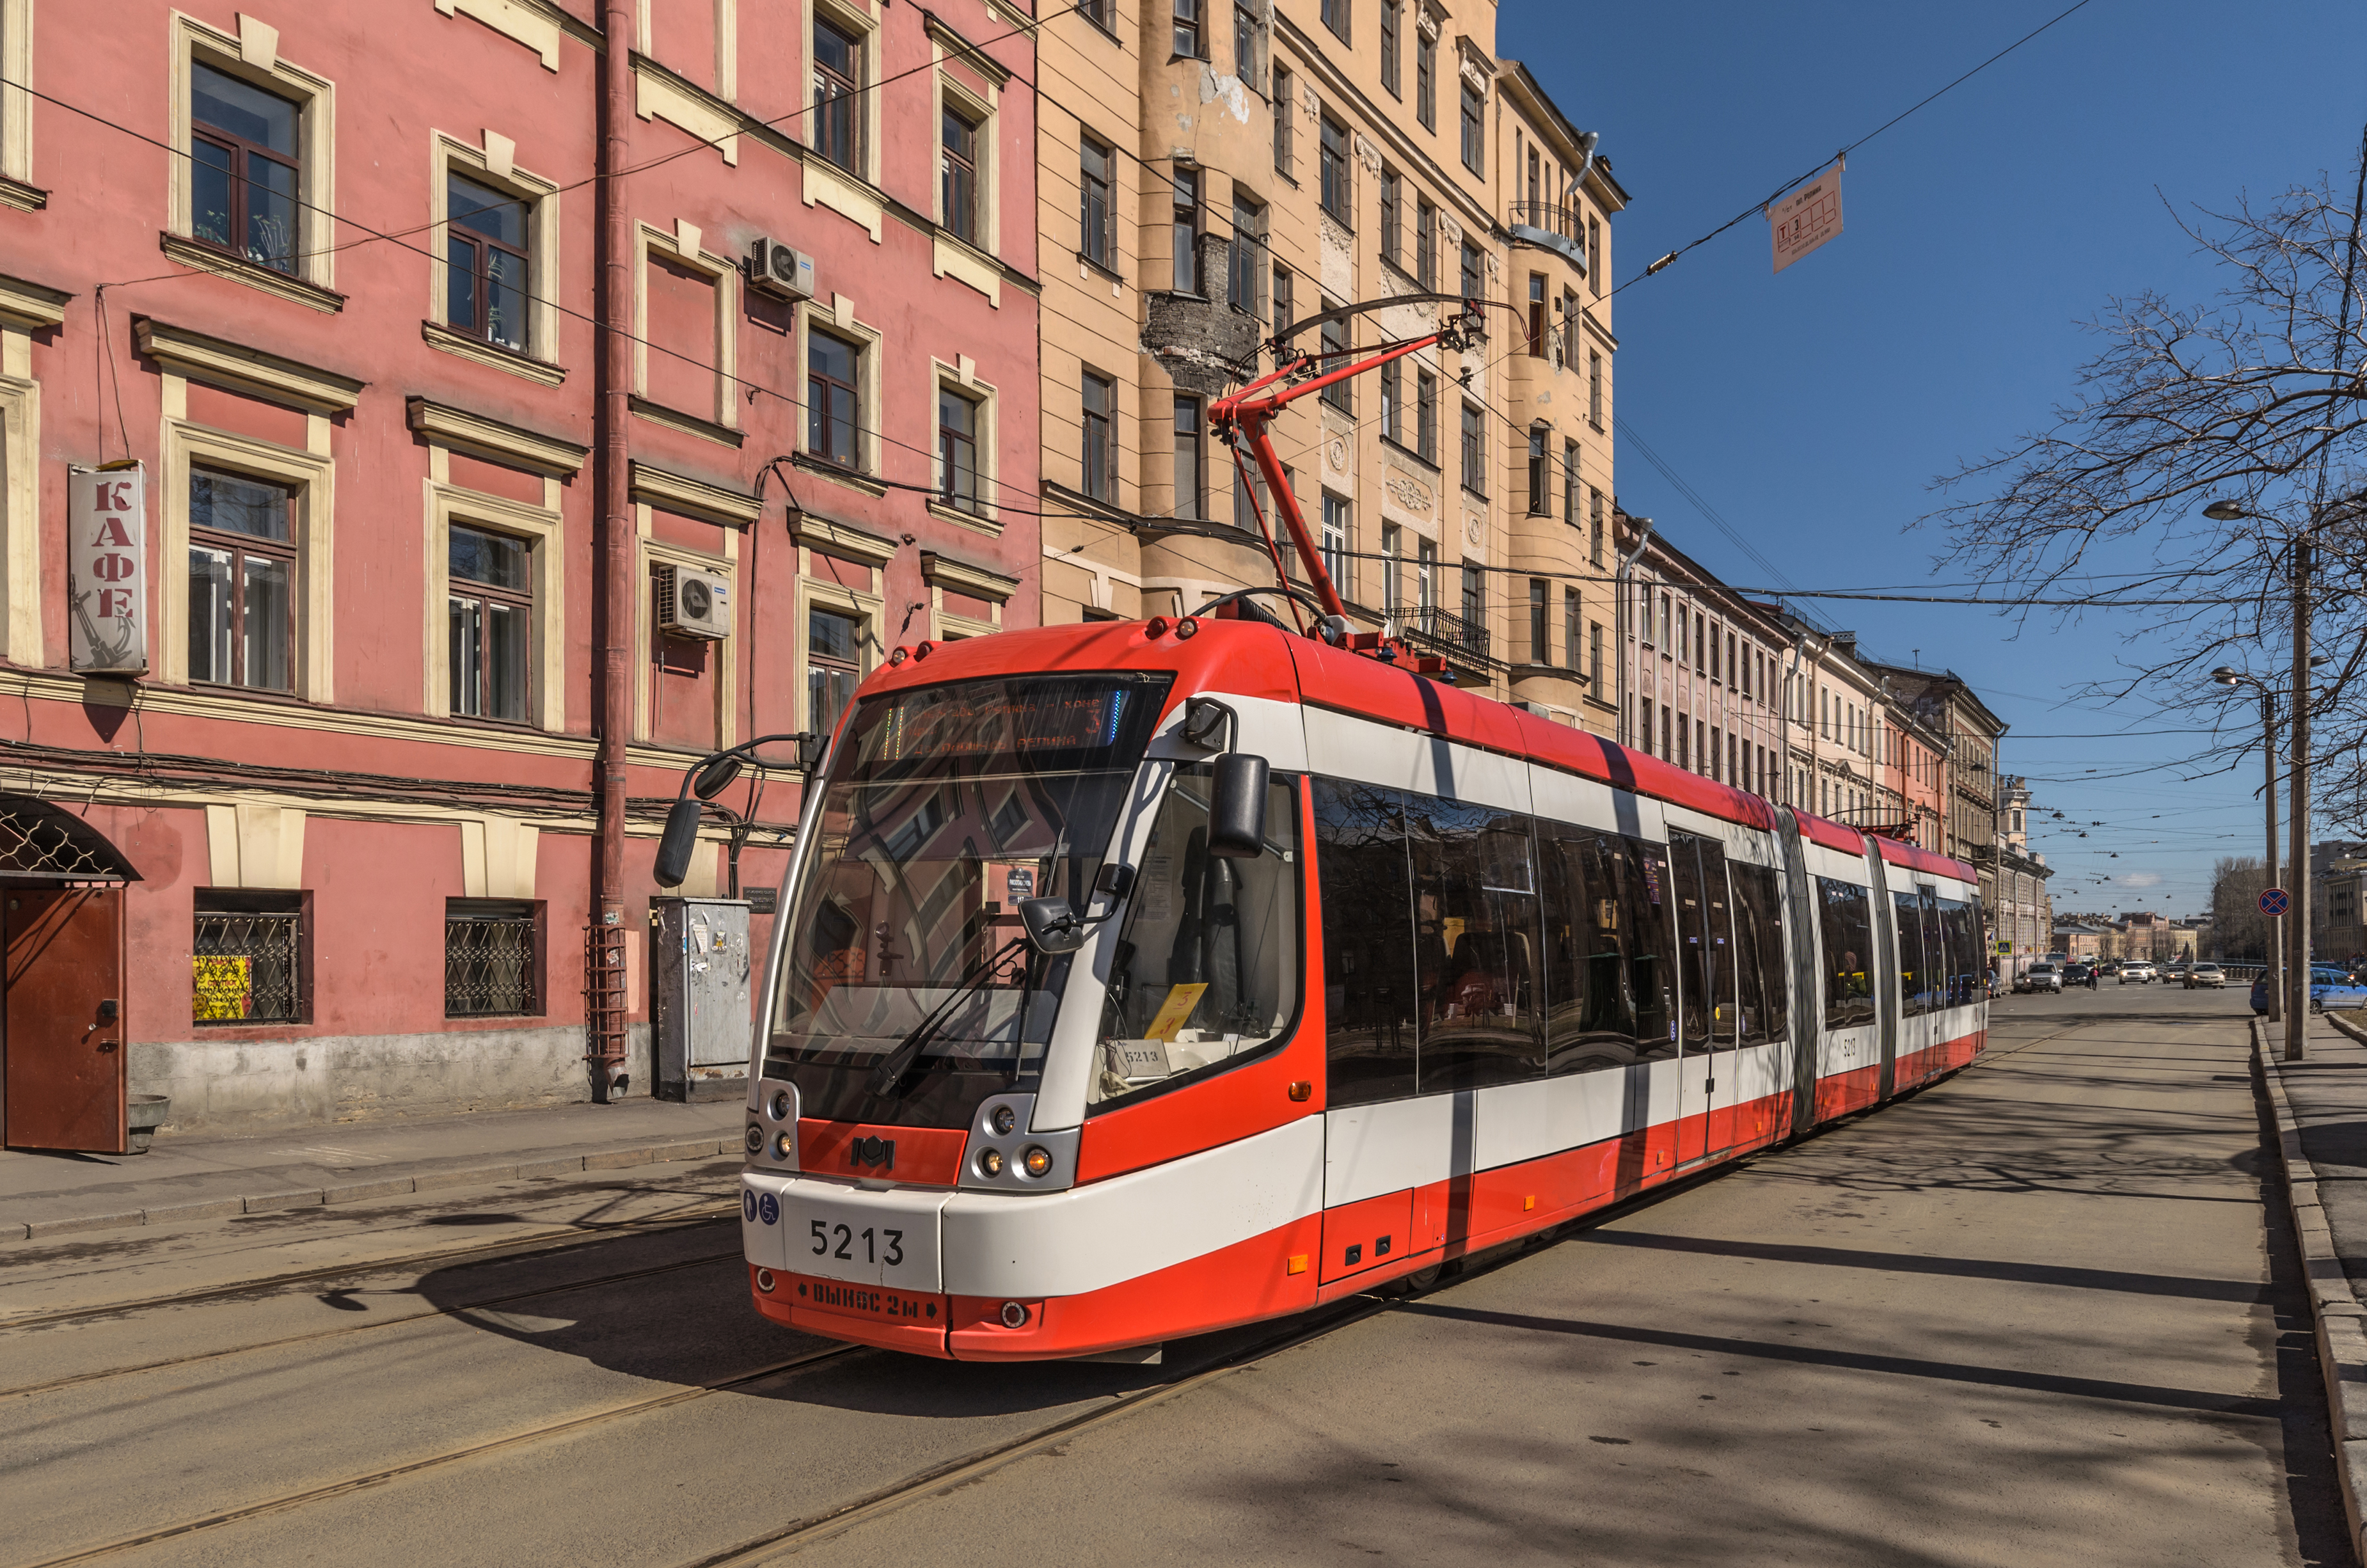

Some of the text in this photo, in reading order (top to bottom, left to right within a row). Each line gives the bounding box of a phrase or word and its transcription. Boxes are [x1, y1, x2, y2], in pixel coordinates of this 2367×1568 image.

[1794, 219, 1799, 231] 3
[91, 481, 134, 618] КАФЕ
[1085, 709, 1101, 734] 3
[1017, 735, 1076, 748] РЕПИНА
[1125, 1050, 1159, 1063] 5213
[1844, 1038, 1856, 1057] 5213
[811, 1219, 903, 1266] 5213
[814, 1283, 880, 1312] ВЫНОС
